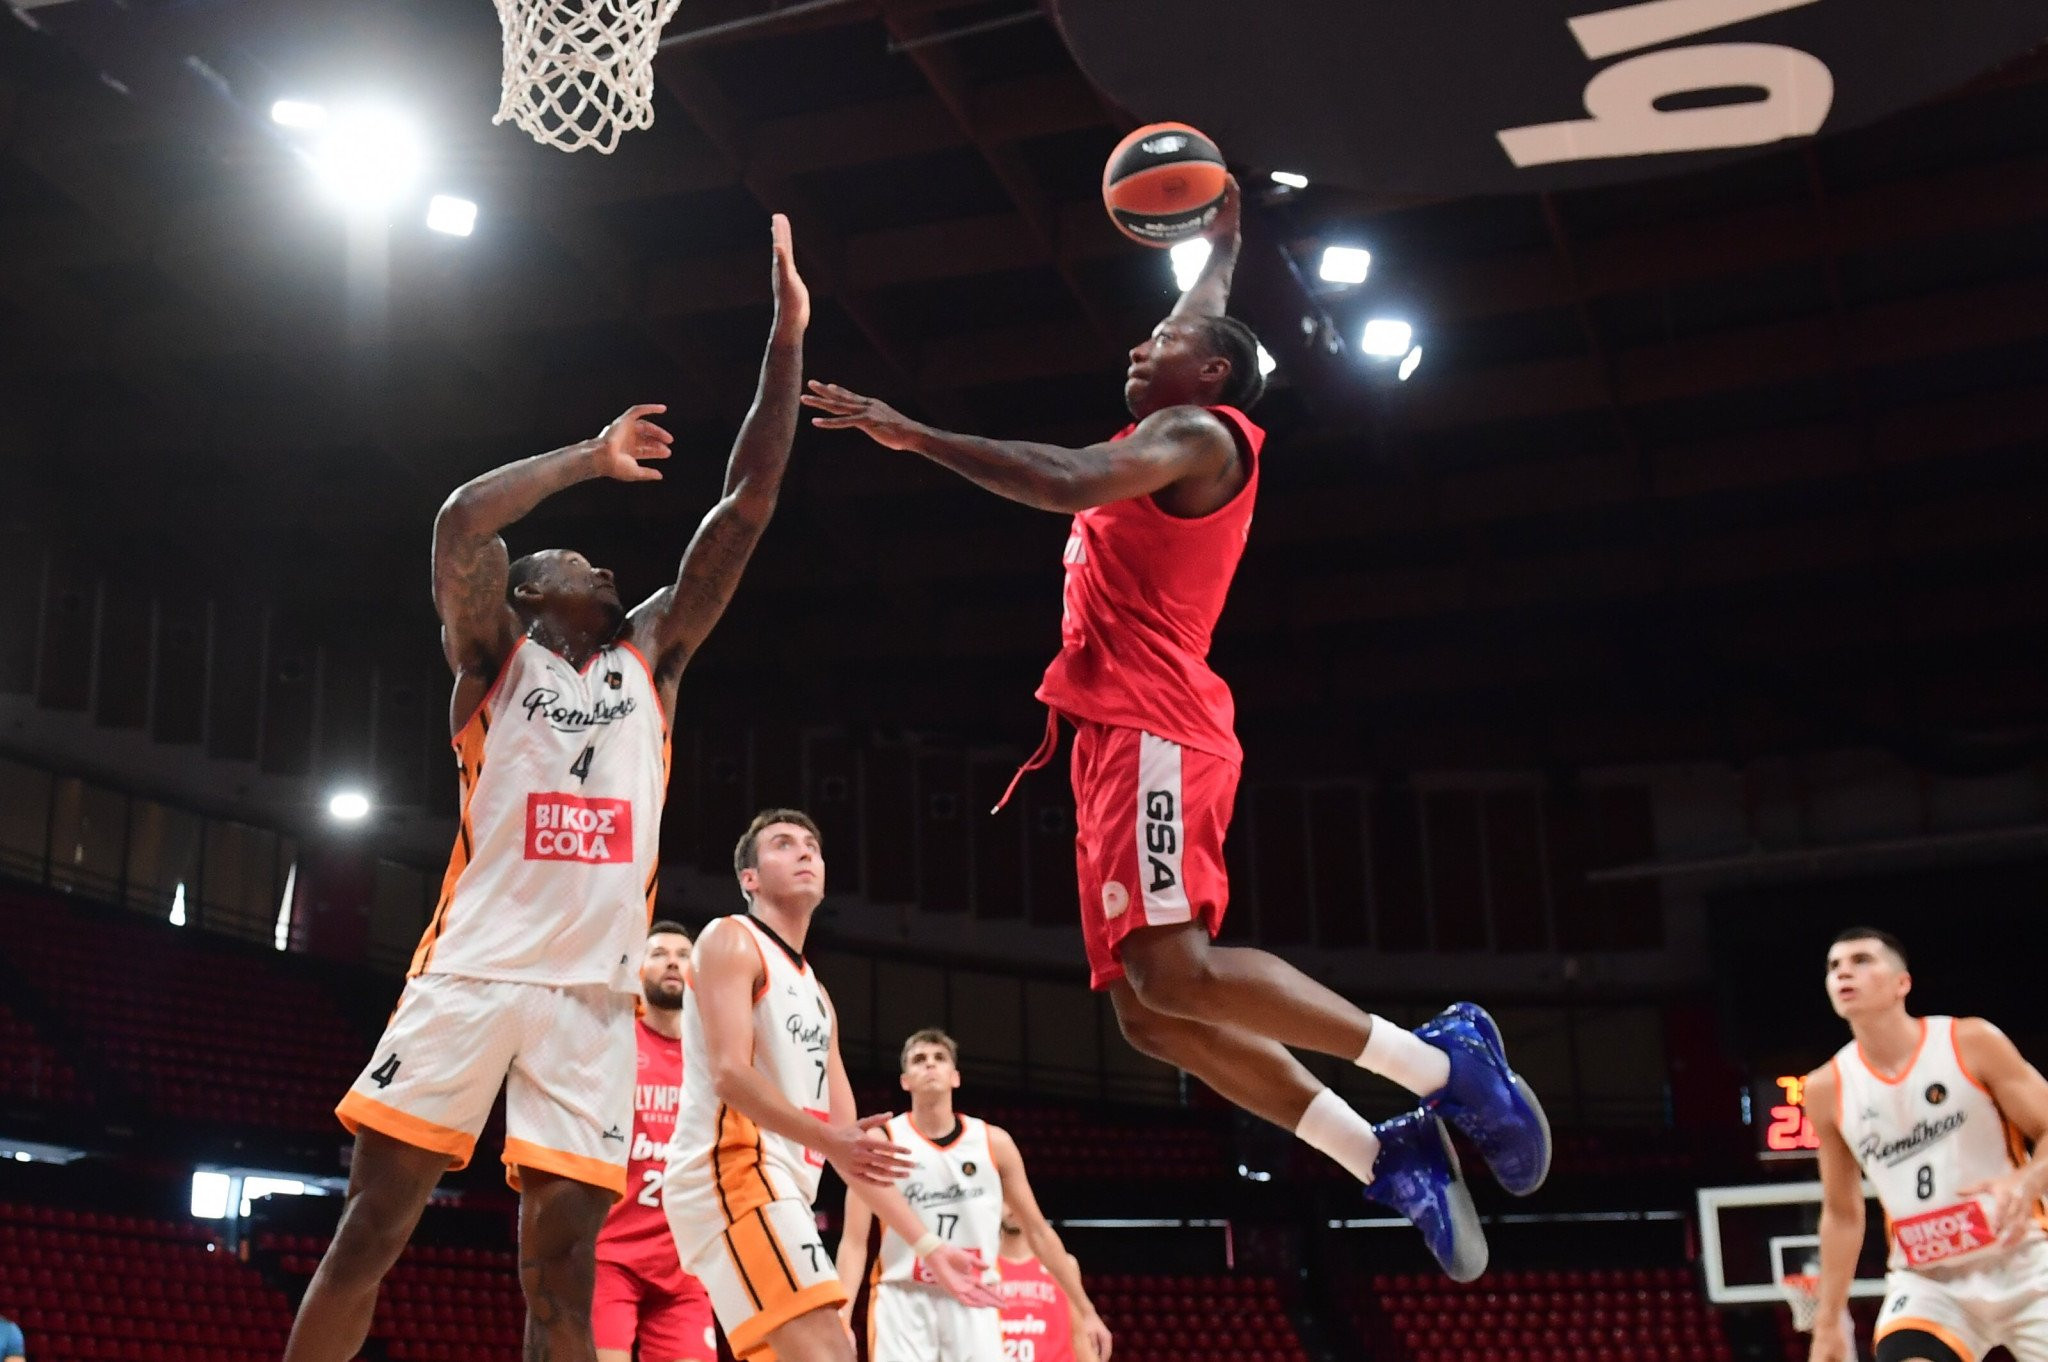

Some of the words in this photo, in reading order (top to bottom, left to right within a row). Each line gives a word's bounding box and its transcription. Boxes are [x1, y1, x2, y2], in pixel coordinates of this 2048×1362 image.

[1496, 0, 1834, 168] b
[570, 746, 594, 785] 4
[534, 830, 611, 859] COLA
[1146, 790, 1176, 893] GSA
[371, 1053, 401, 1088] 4
[1917, 1165, 1934, 1200] 8
[937, 1214, 959, 1240] 17
[1003, 1338, 1035, 1362] 20
